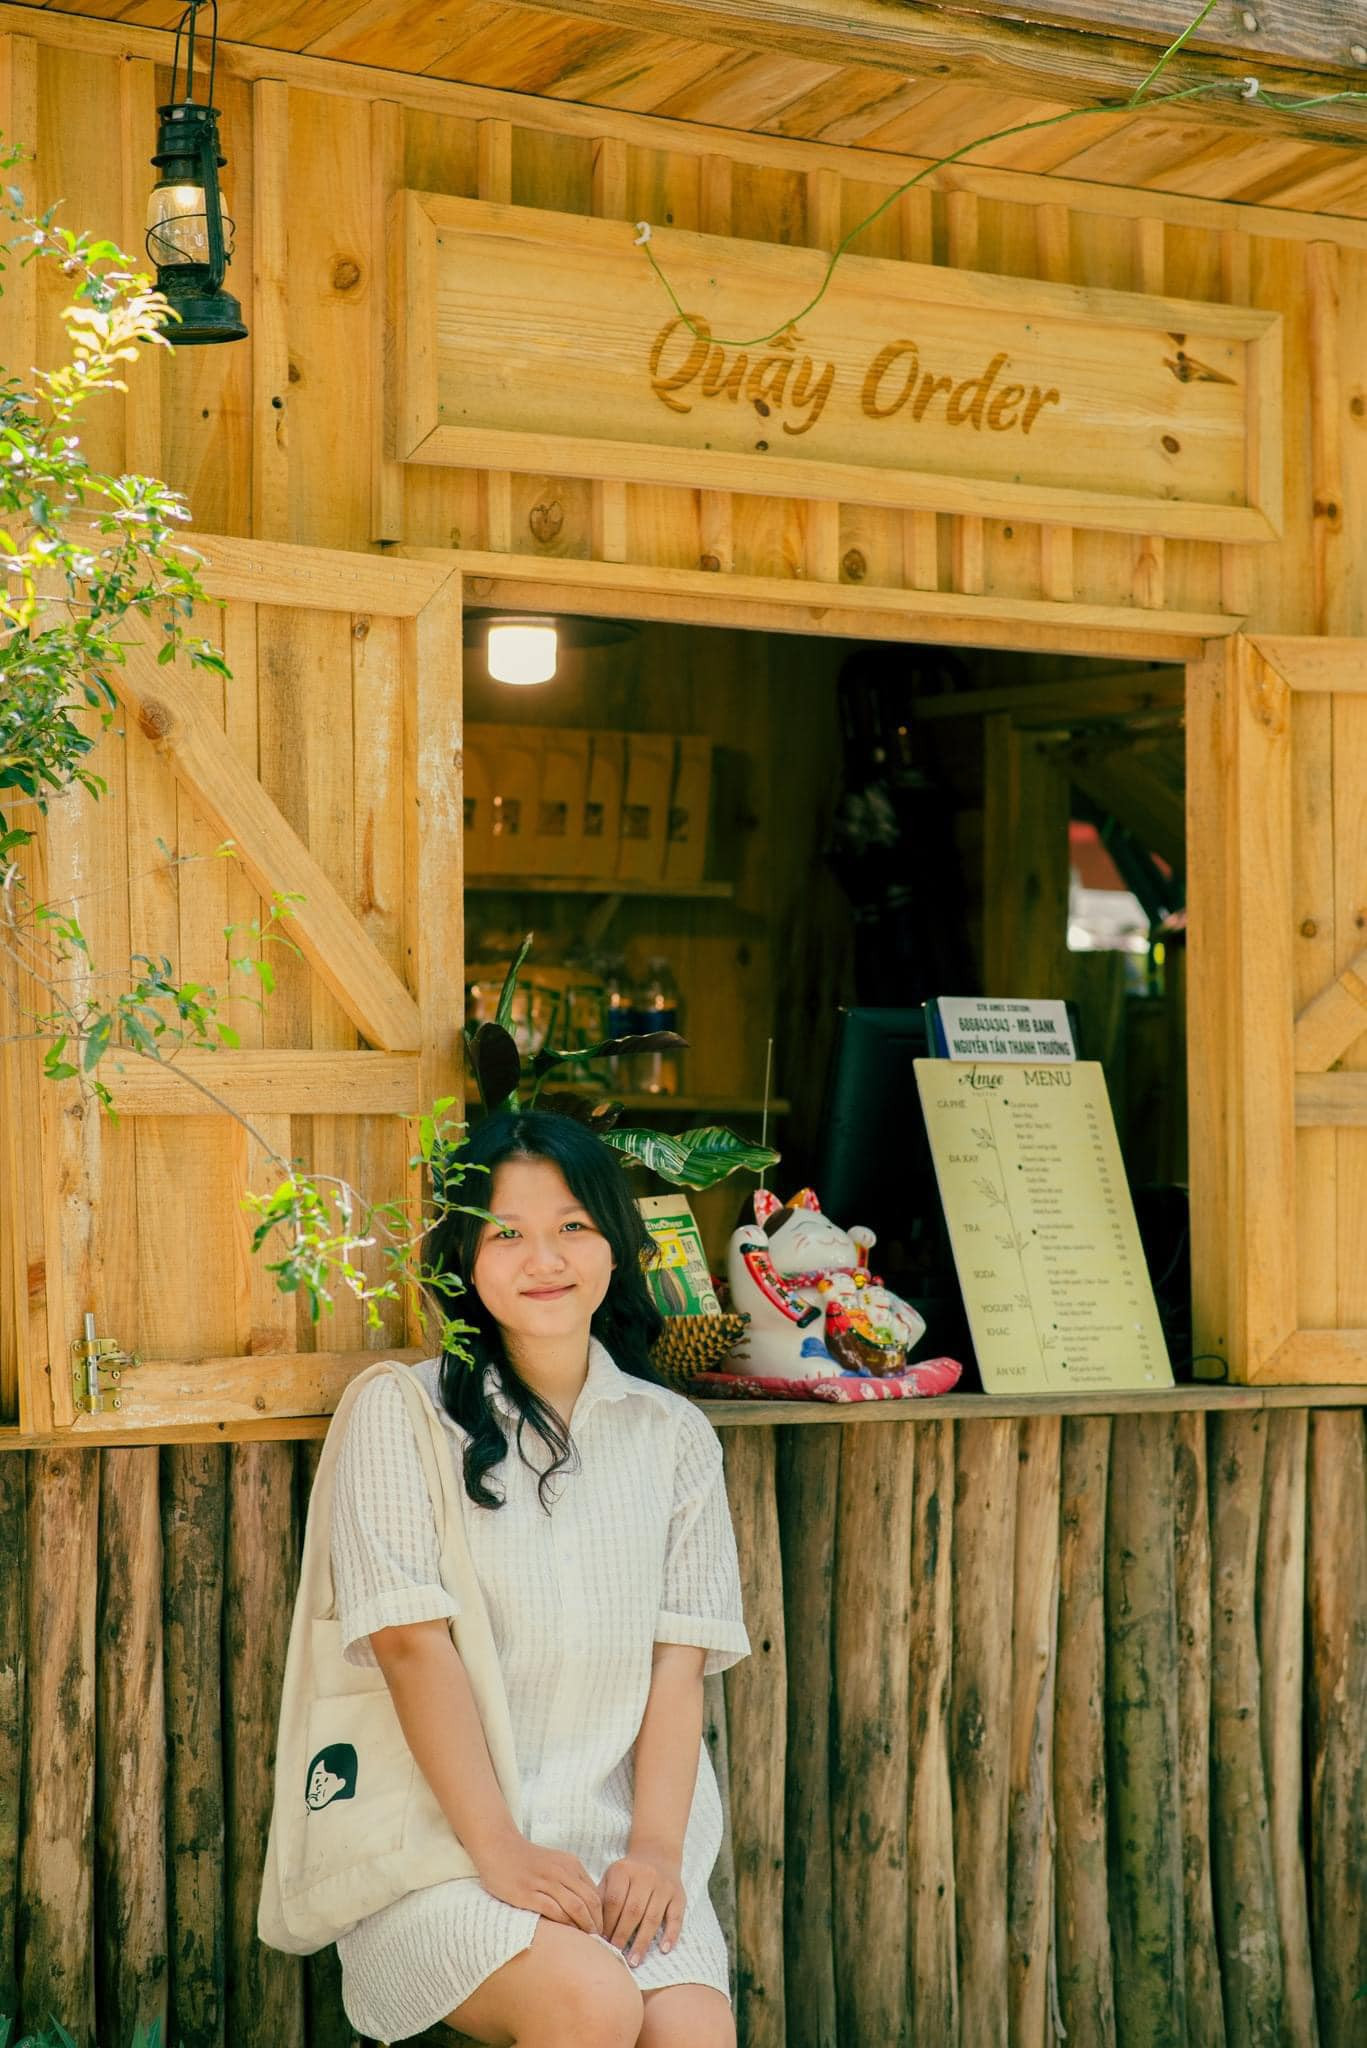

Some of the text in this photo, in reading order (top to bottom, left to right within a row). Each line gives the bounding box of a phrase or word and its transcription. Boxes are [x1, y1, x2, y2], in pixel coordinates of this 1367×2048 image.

[861, 339, 1060, 434] Order
[1032, 1018, 1056, 1033] BANK
[1023, 1070, 1072, 1087] MENU
